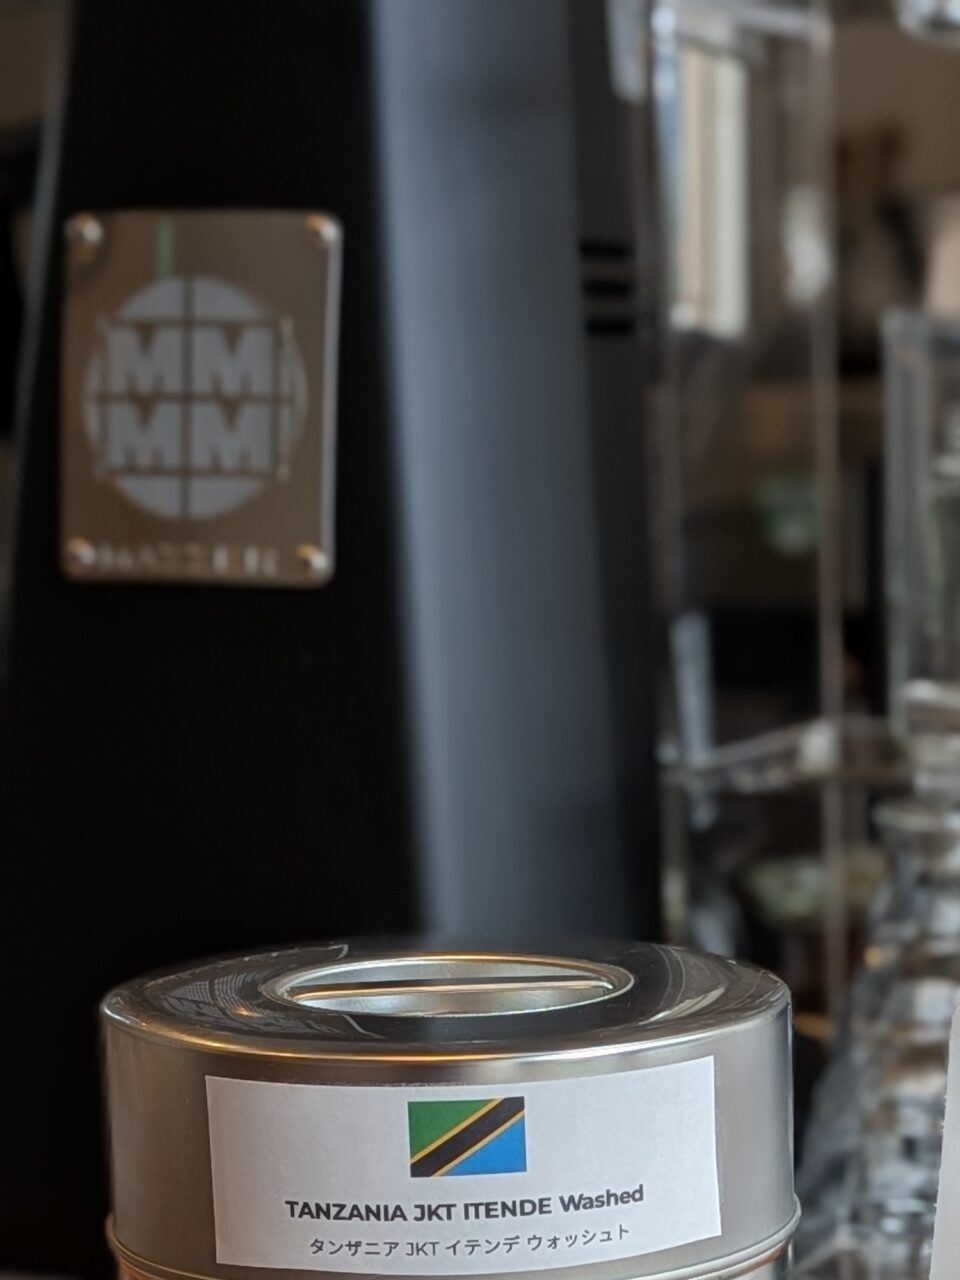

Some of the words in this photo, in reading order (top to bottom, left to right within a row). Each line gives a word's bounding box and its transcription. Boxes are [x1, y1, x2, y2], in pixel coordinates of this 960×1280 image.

[285, 1199, 408, 1223] TANZANIA
[412, 1203, 457, 1222] JKT
[463, 1197, 553, 1220] ITENDE
[557, 1184, 644, 1212] Washed
[310, 1237, 400, 1257] タンザニア
[405, 1241, 440, 1257] JKT
[445, 1235, 521, 1256] イテンデ
[527, 1224, 630, 1251] ウォッシュト
